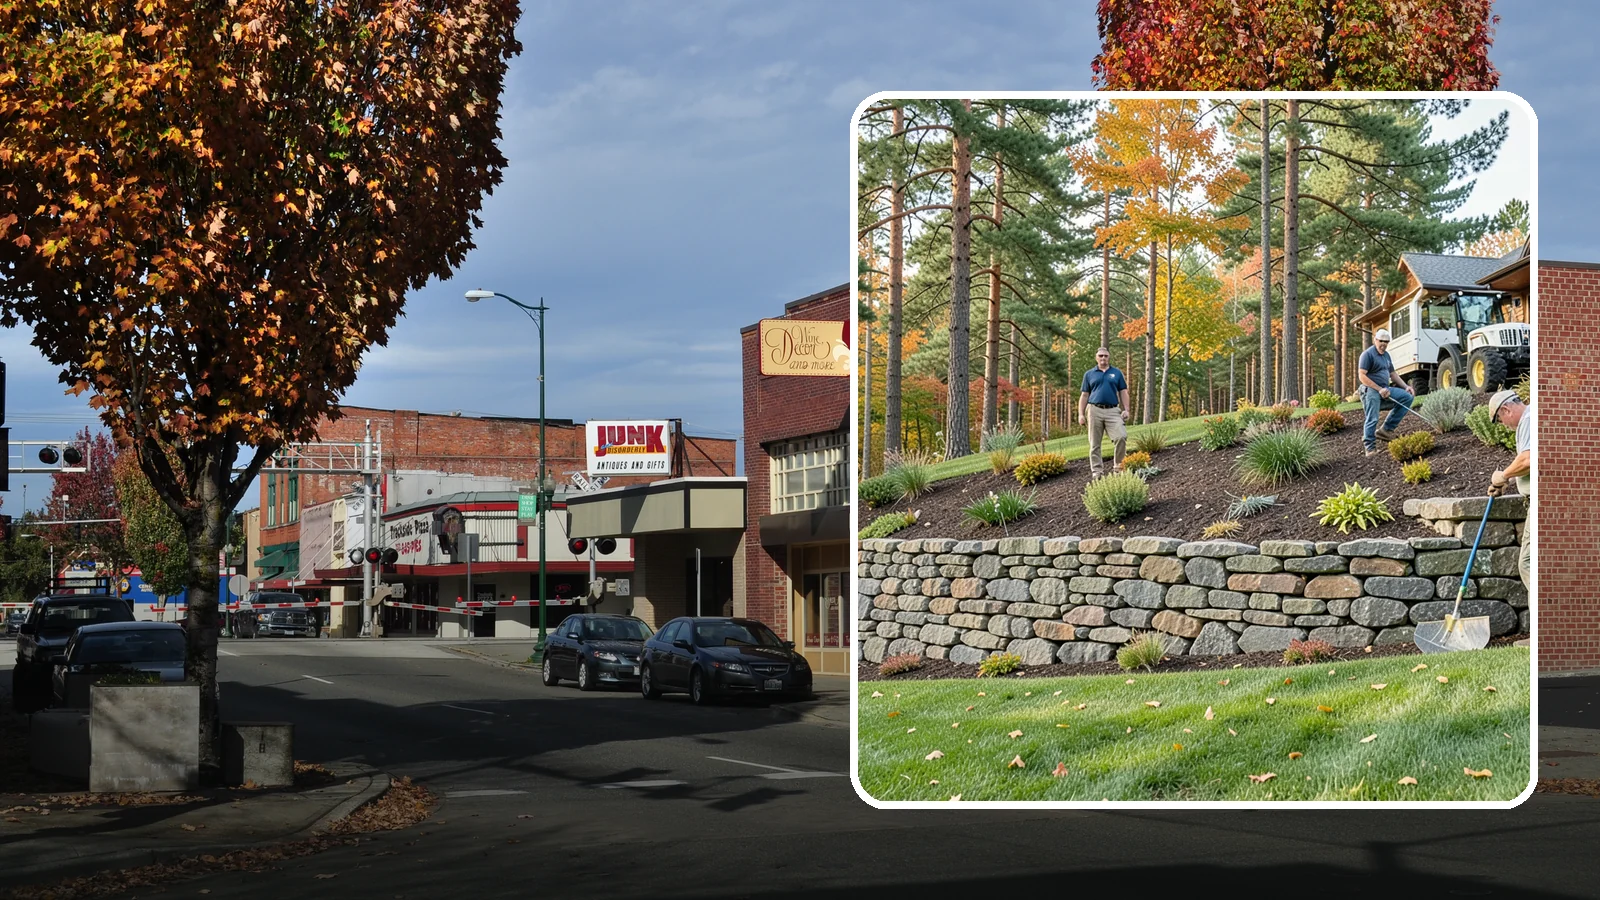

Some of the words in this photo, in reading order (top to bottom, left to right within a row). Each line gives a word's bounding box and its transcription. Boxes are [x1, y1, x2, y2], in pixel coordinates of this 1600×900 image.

[595, 425, 665, 457] JUNK
[607, 446, 645, 454] DISORDERLY
[597, 461, 628, 470] ANTIQUES
[631, 461, 644, 470] AND
[647, 460, 665, 470] GIFTS
[573, 473, 589, 492] RAIL
[414, 519, 429, 535] Pizza
